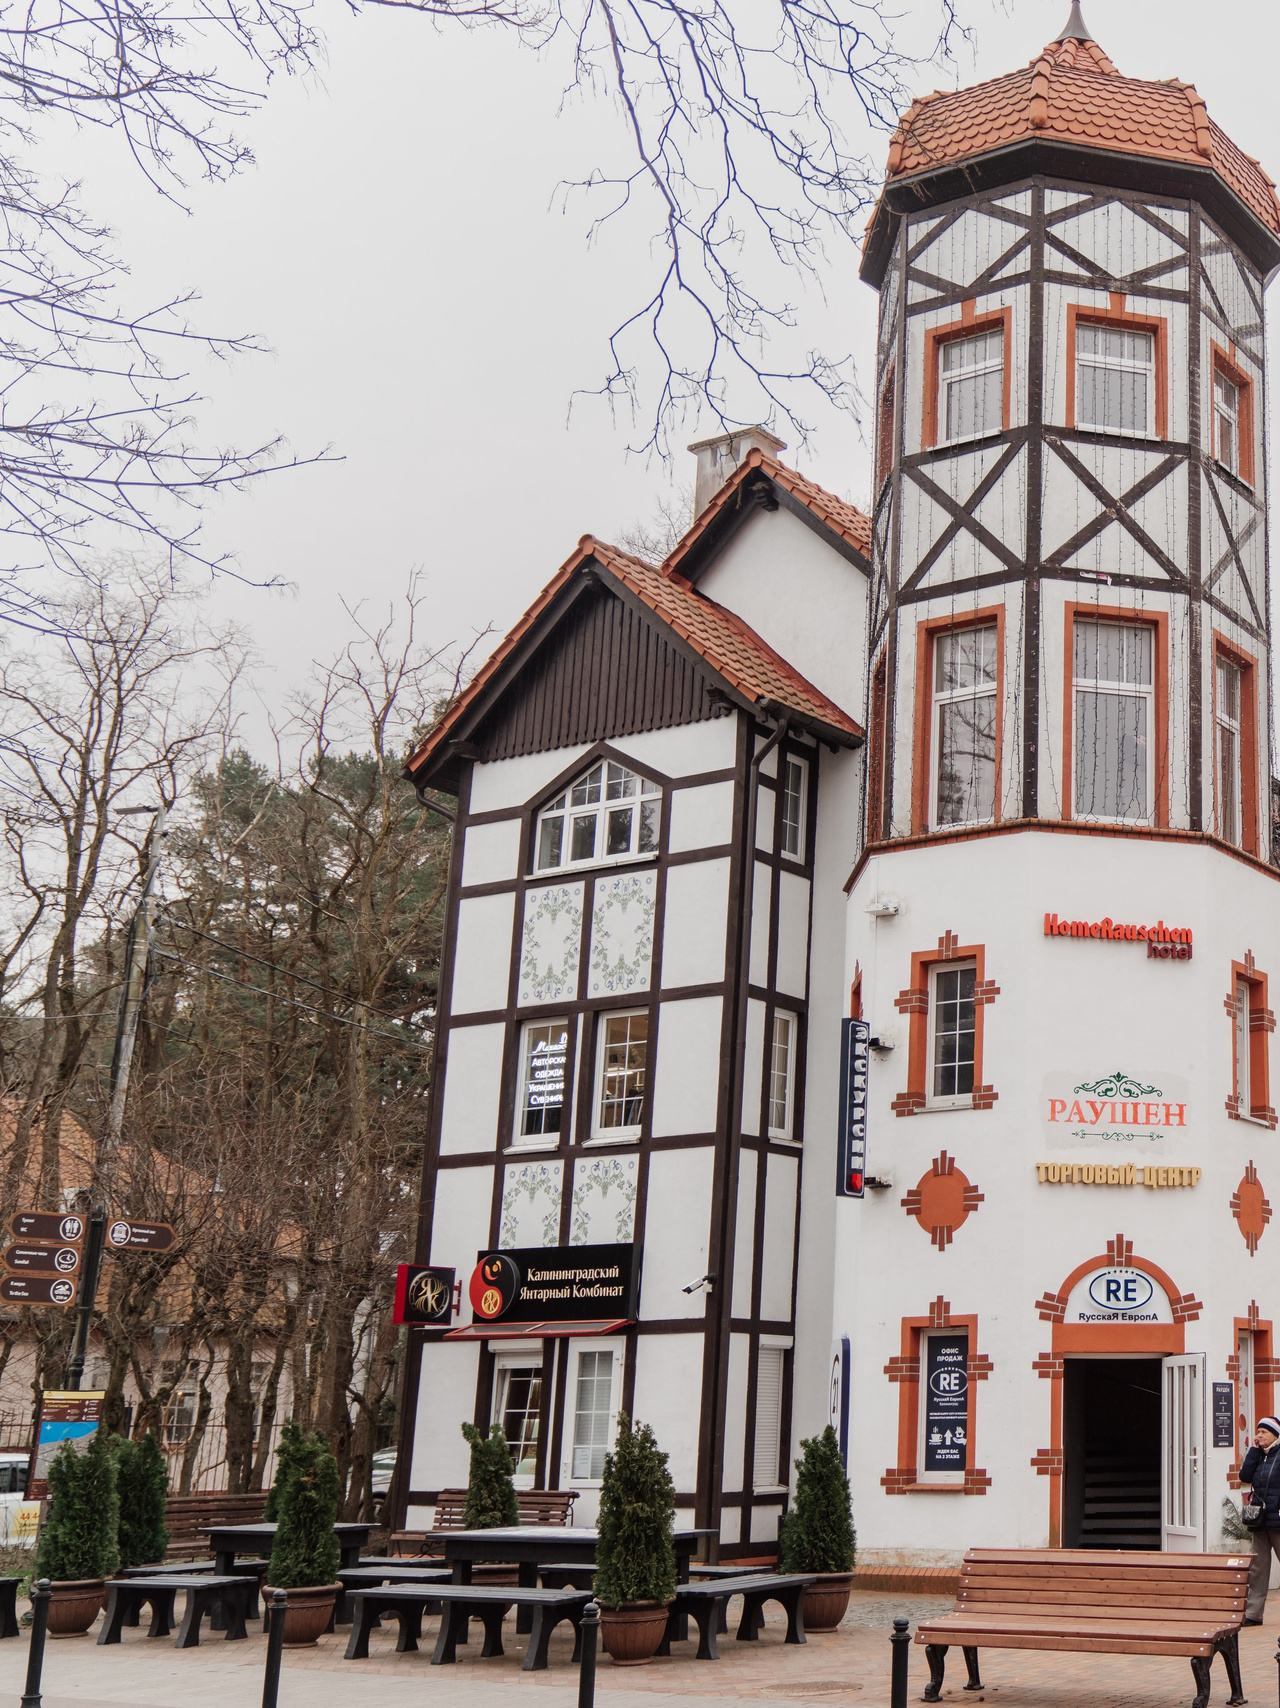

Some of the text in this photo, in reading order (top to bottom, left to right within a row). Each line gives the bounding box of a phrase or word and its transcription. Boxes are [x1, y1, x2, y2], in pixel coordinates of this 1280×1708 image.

[1044, 913, 1193, 943] HomeRauschen
[1147, 942, 1193, 960] hotel
[532, 1056, 567, 1067] АВТОРСКА
[530, 1095, 563, 1105] СУВЕНИР
[850, 1027, 867, 1169] ЭКСКУРСИИ
[1048, 1098, 1187, 1127] РАУШЕН
[1036, 1161, 1202, 1189] ТОРГОВЫЙ ЦЕНТР
[527, 1265, 620, 1283] Калининградский
[519, 1284, 625, 1302] Янтарный Комбинат
[1106, 1279, 1137, 1302] RE
[1122, 1313, 1158, 1323] ЕвропА
[940, 1373, 960, 1390] RE
